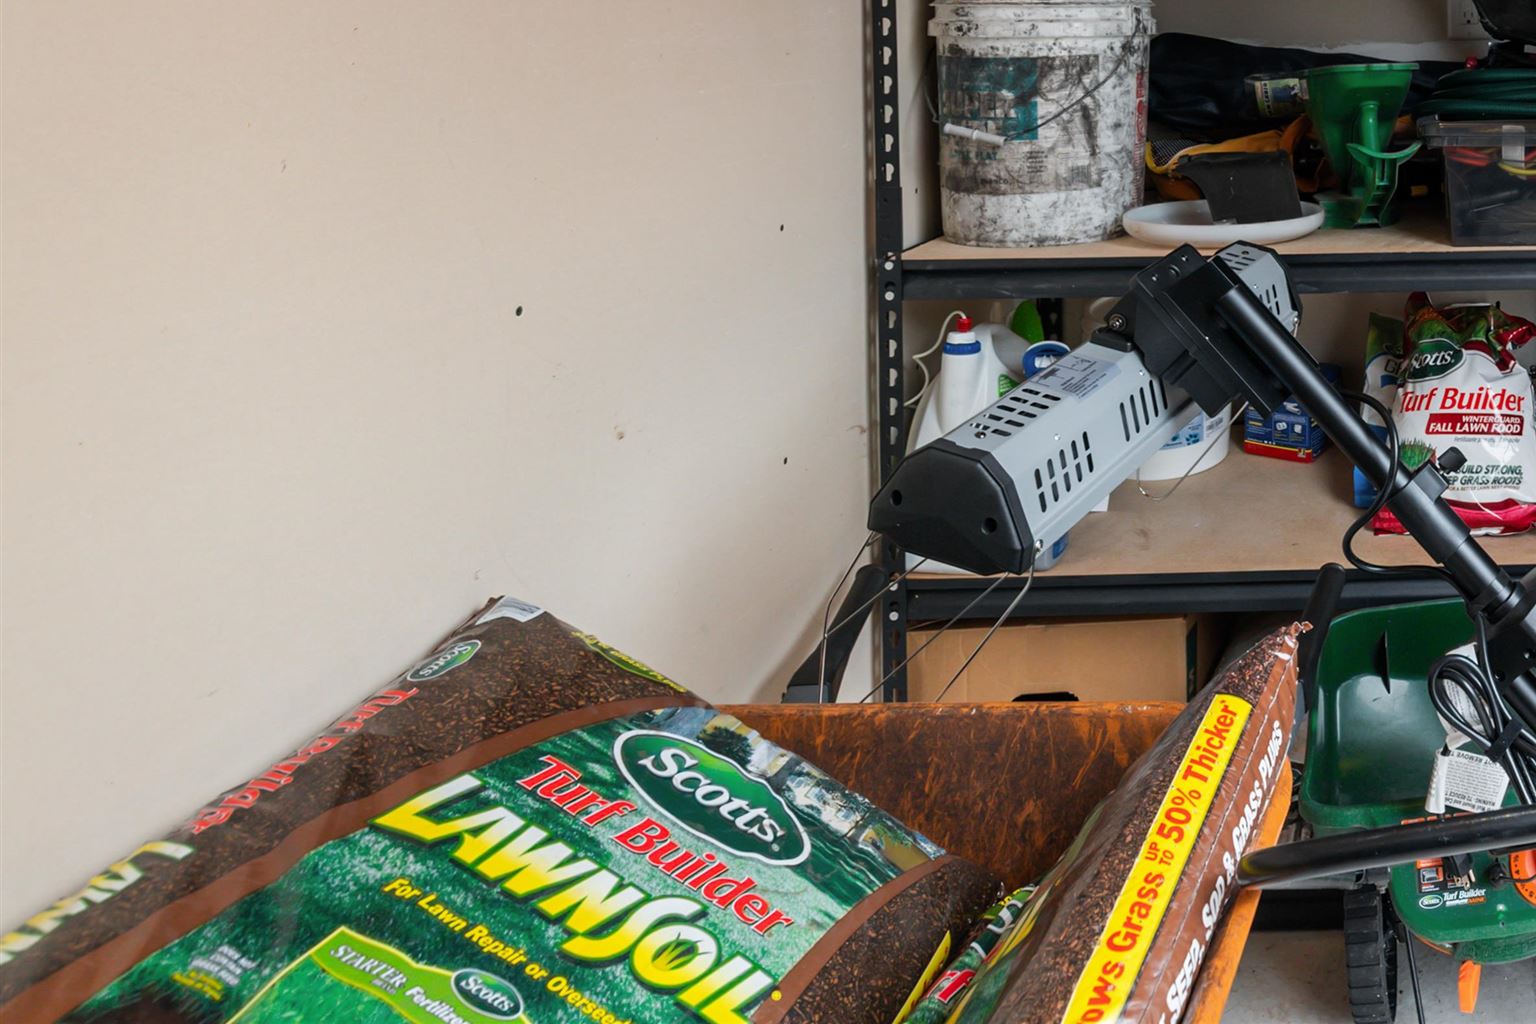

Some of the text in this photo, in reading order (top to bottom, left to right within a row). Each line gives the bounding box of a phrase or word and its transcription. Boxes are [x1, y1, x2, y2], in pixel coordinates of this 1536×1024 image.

[1400, 386, 1525, 413] Turf Builder
[1428, 423, 1521, 434] FALL LAWN FOOD
[1455, 465, 1483, 476] UILD
[1460, 476, 1490, 486] GRASS
[1492, 476, 1523, 486] ROOTS
[419, 643, 472, 677] Scotts
[190, 734, 342, 835] Builder
[638, 747, 786, 852] Scotts
[515, 754, 794, 936] Turf Builder
[1158, 849, 1175, 866] TO
[1202, 875, 1225, 941] SOD
[1232, 779, 1264, 861] GRASS
[368, 773, 777, 1024] LAWNSOIL
[1077, 960, 1125, 1024] ows
[1106, 871, 1165, 953] Grass
[1145, 842, 1161, 862] UP
[1156, 788, 1202, 844] 50%
[1442, 888, 1487, 901] Turf Builder
[329, 944, 409, 989] STARTER
[383, 877, 633, 1024] For Lawn Repair or Oversee
[459, 974, 516, 1012] Scotts
